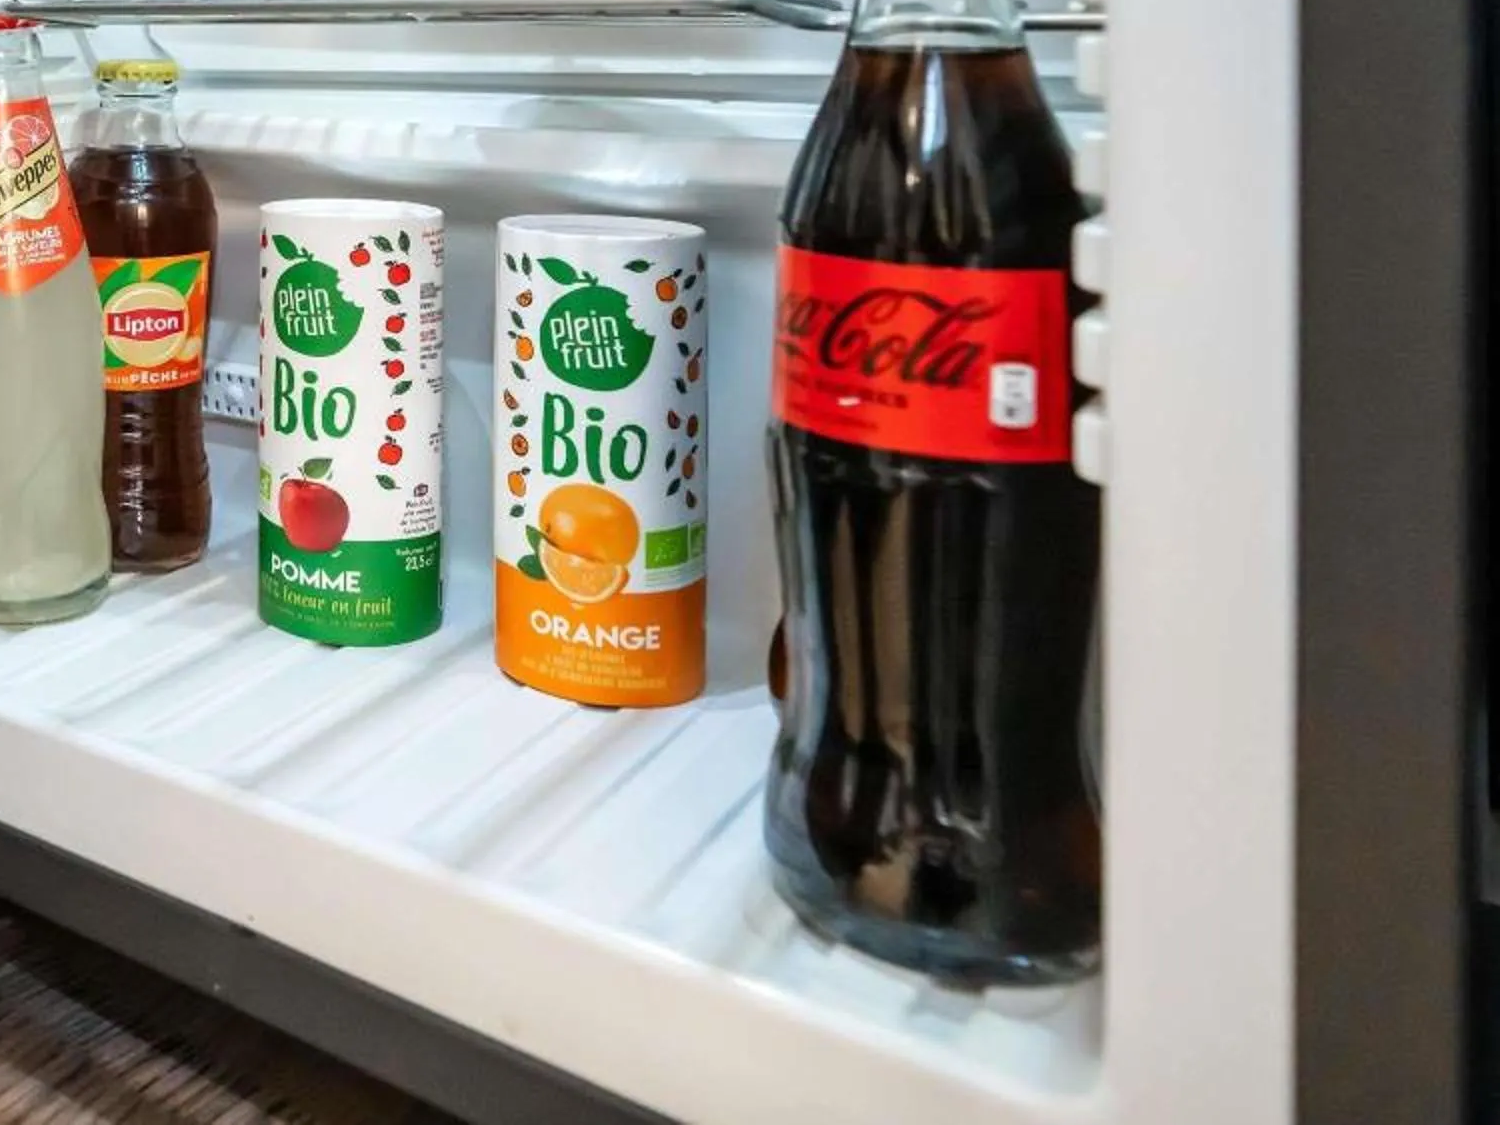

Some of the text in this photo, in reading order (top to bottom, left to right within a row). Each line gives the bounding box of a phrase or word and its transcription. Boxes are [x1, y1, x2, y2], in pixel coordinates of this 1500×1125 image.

[279, 283, 330, 317] plein
[113, 314, 179, 336] Lipton
[285, 309, 337, 336] fruit
[550, 310, 619, 350] plein
[560, 338, 628, 370] fruit
[273, 356, 357, 442] Bio
[541, 391, 648, 485] Bio
[271, 551, 362, 594] POMME
[529, 608, 662, 651] ORANGE
